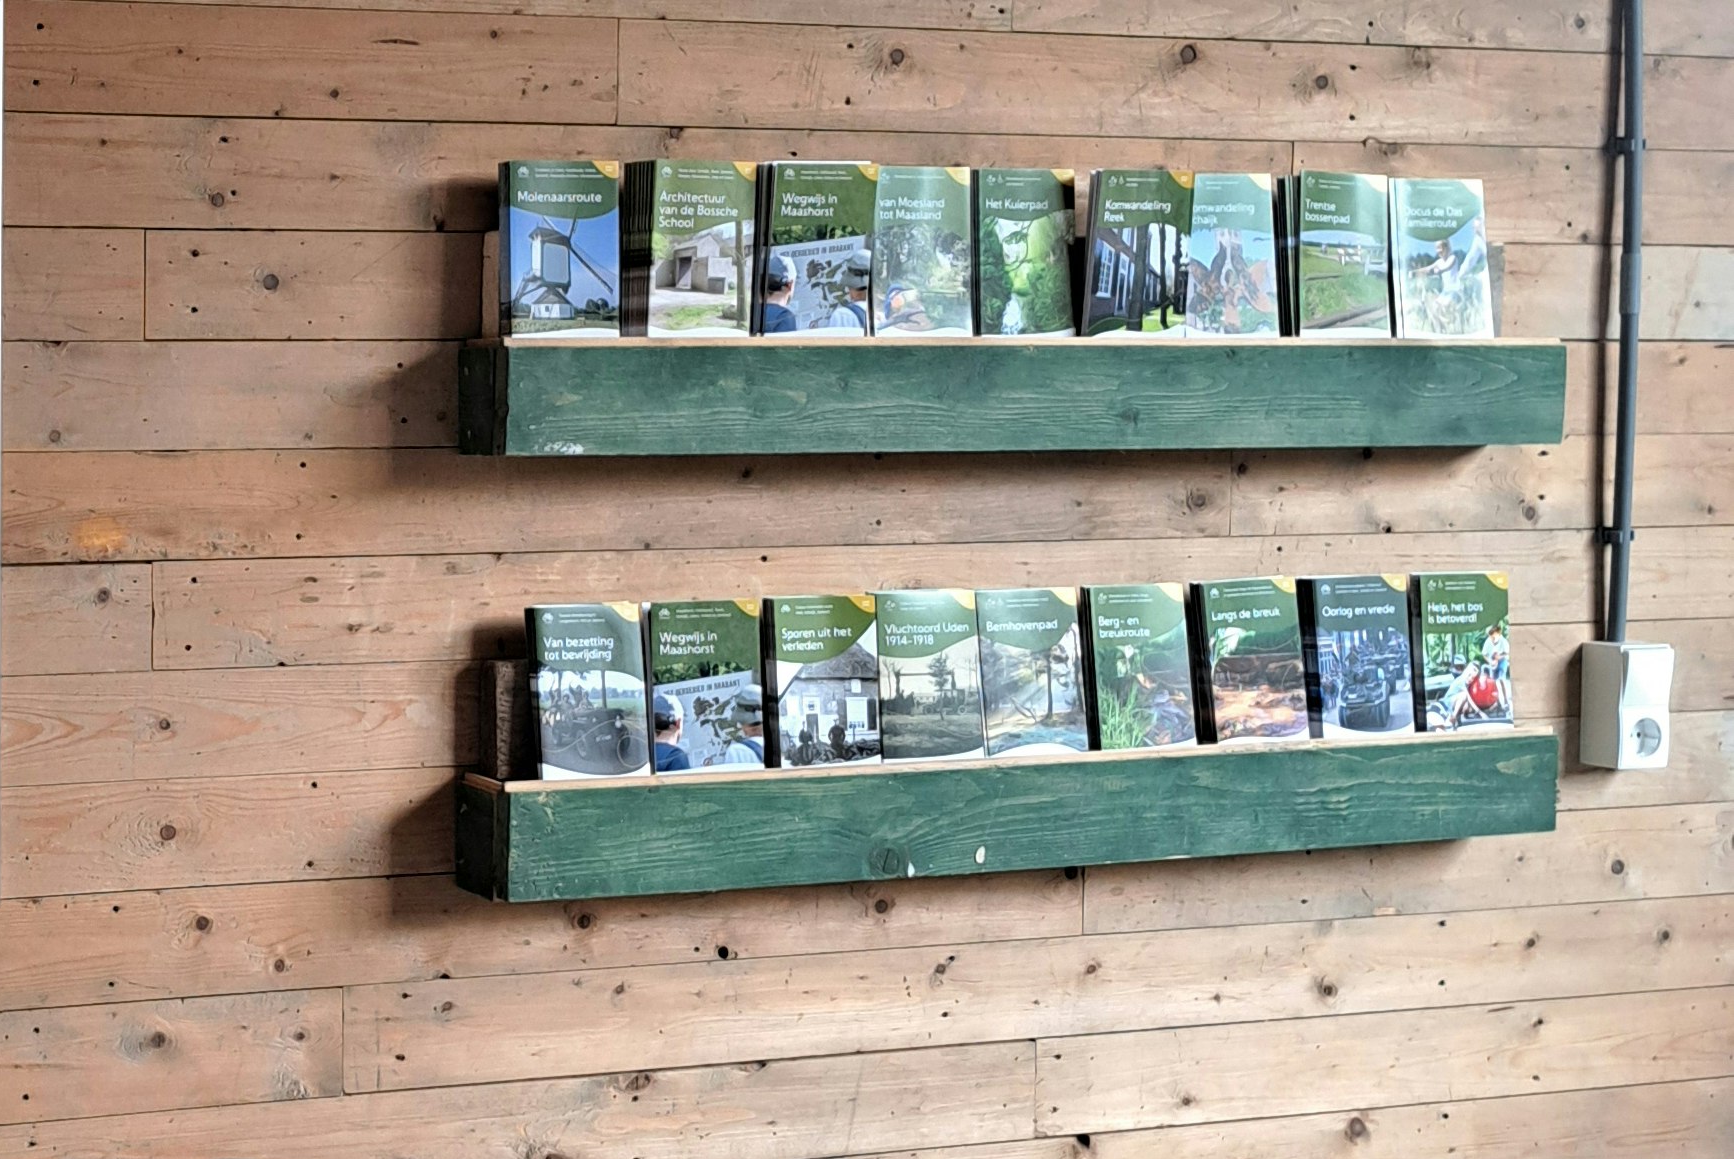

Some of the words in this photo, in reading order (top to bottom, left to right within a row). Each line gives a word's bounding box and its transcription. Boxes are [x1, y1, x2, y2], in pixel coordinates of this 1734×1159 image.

[517, 190, 602, 204] Molenaarsroute
[659, 190, 726, 204] Architectuur
[782, 192, 825, 207] Wegwijs
[828, 194, 837, 204] in
[880, 199, 896, 207] van
[899, 196, 945, 208] Moesland
[659, 206, 677, 215] van
[680, 205, 694, 215] de
[696, 204, 739, 217] Bossche
[781, 206, 834, 217] Maashorst
[986, 198, 1002, 209] Het
[1005, 198, 1049, 213] Kuierpad
[1106, 199, 1172, 216] Komwandeling
[1193, 202, 1255, 215] omwandeling
[1305, 199, 1336, 211] Trentse
[1433, 207, 1445, 217] de
[1446, 206, 1462, 216] Das
[880, 211, 894, 219] tot
[896, 210, 942, 220] Maasland
[1104, 212, 1125, 222] Reek
[1193, 215, 1219, 226] chaijk
[1305, 212, 1350, 225] bossenpad
[659, 217, 694, 229] School
[1212, 609, 1237, 622] Langs
[1239, 609, 1251, 619] de
[1254, 607, 1280, 618] breuk
[1322, 606, 1352, 619] Oorlog
[1355, 607, 1366, 616] en
[1368, 604, 1395, 615] vrede
[1428, 603, 1449, 615] Help,
[1451, 603, 1466, 612] het
[1468, 602, 1483, 611] bos
[1128, 617, 1139, 626] en
[1428, 614, 1435, 623] is
[1437, 613, 1477, 624] betoverd!
[885, 623, 941, 635] Vluchtoord
[943, 622, 969, 633] Uden
[986, 619, 1057, 633] Bernhovenpad
[659, 631, 705, 647] Wegwijs
[708, 631, 718, 641] in
[782, 628, 816, 641] Sporen
[818, 627, 831, 637] uit
[834, 627, 852, 637] het
[1099, 628, 1150, 638] breukroute
[544, 636, 563, 648] Van
[566, 636, 614, 652] bezetting
[782, 641, 824, 651] verleden
[885, 635, 934, 646] 1914-1918
[659, 644, 714, 656] Maashorst
[544, 651, 560, 661] tot
[562, 651, 612, 664] bevrijding
